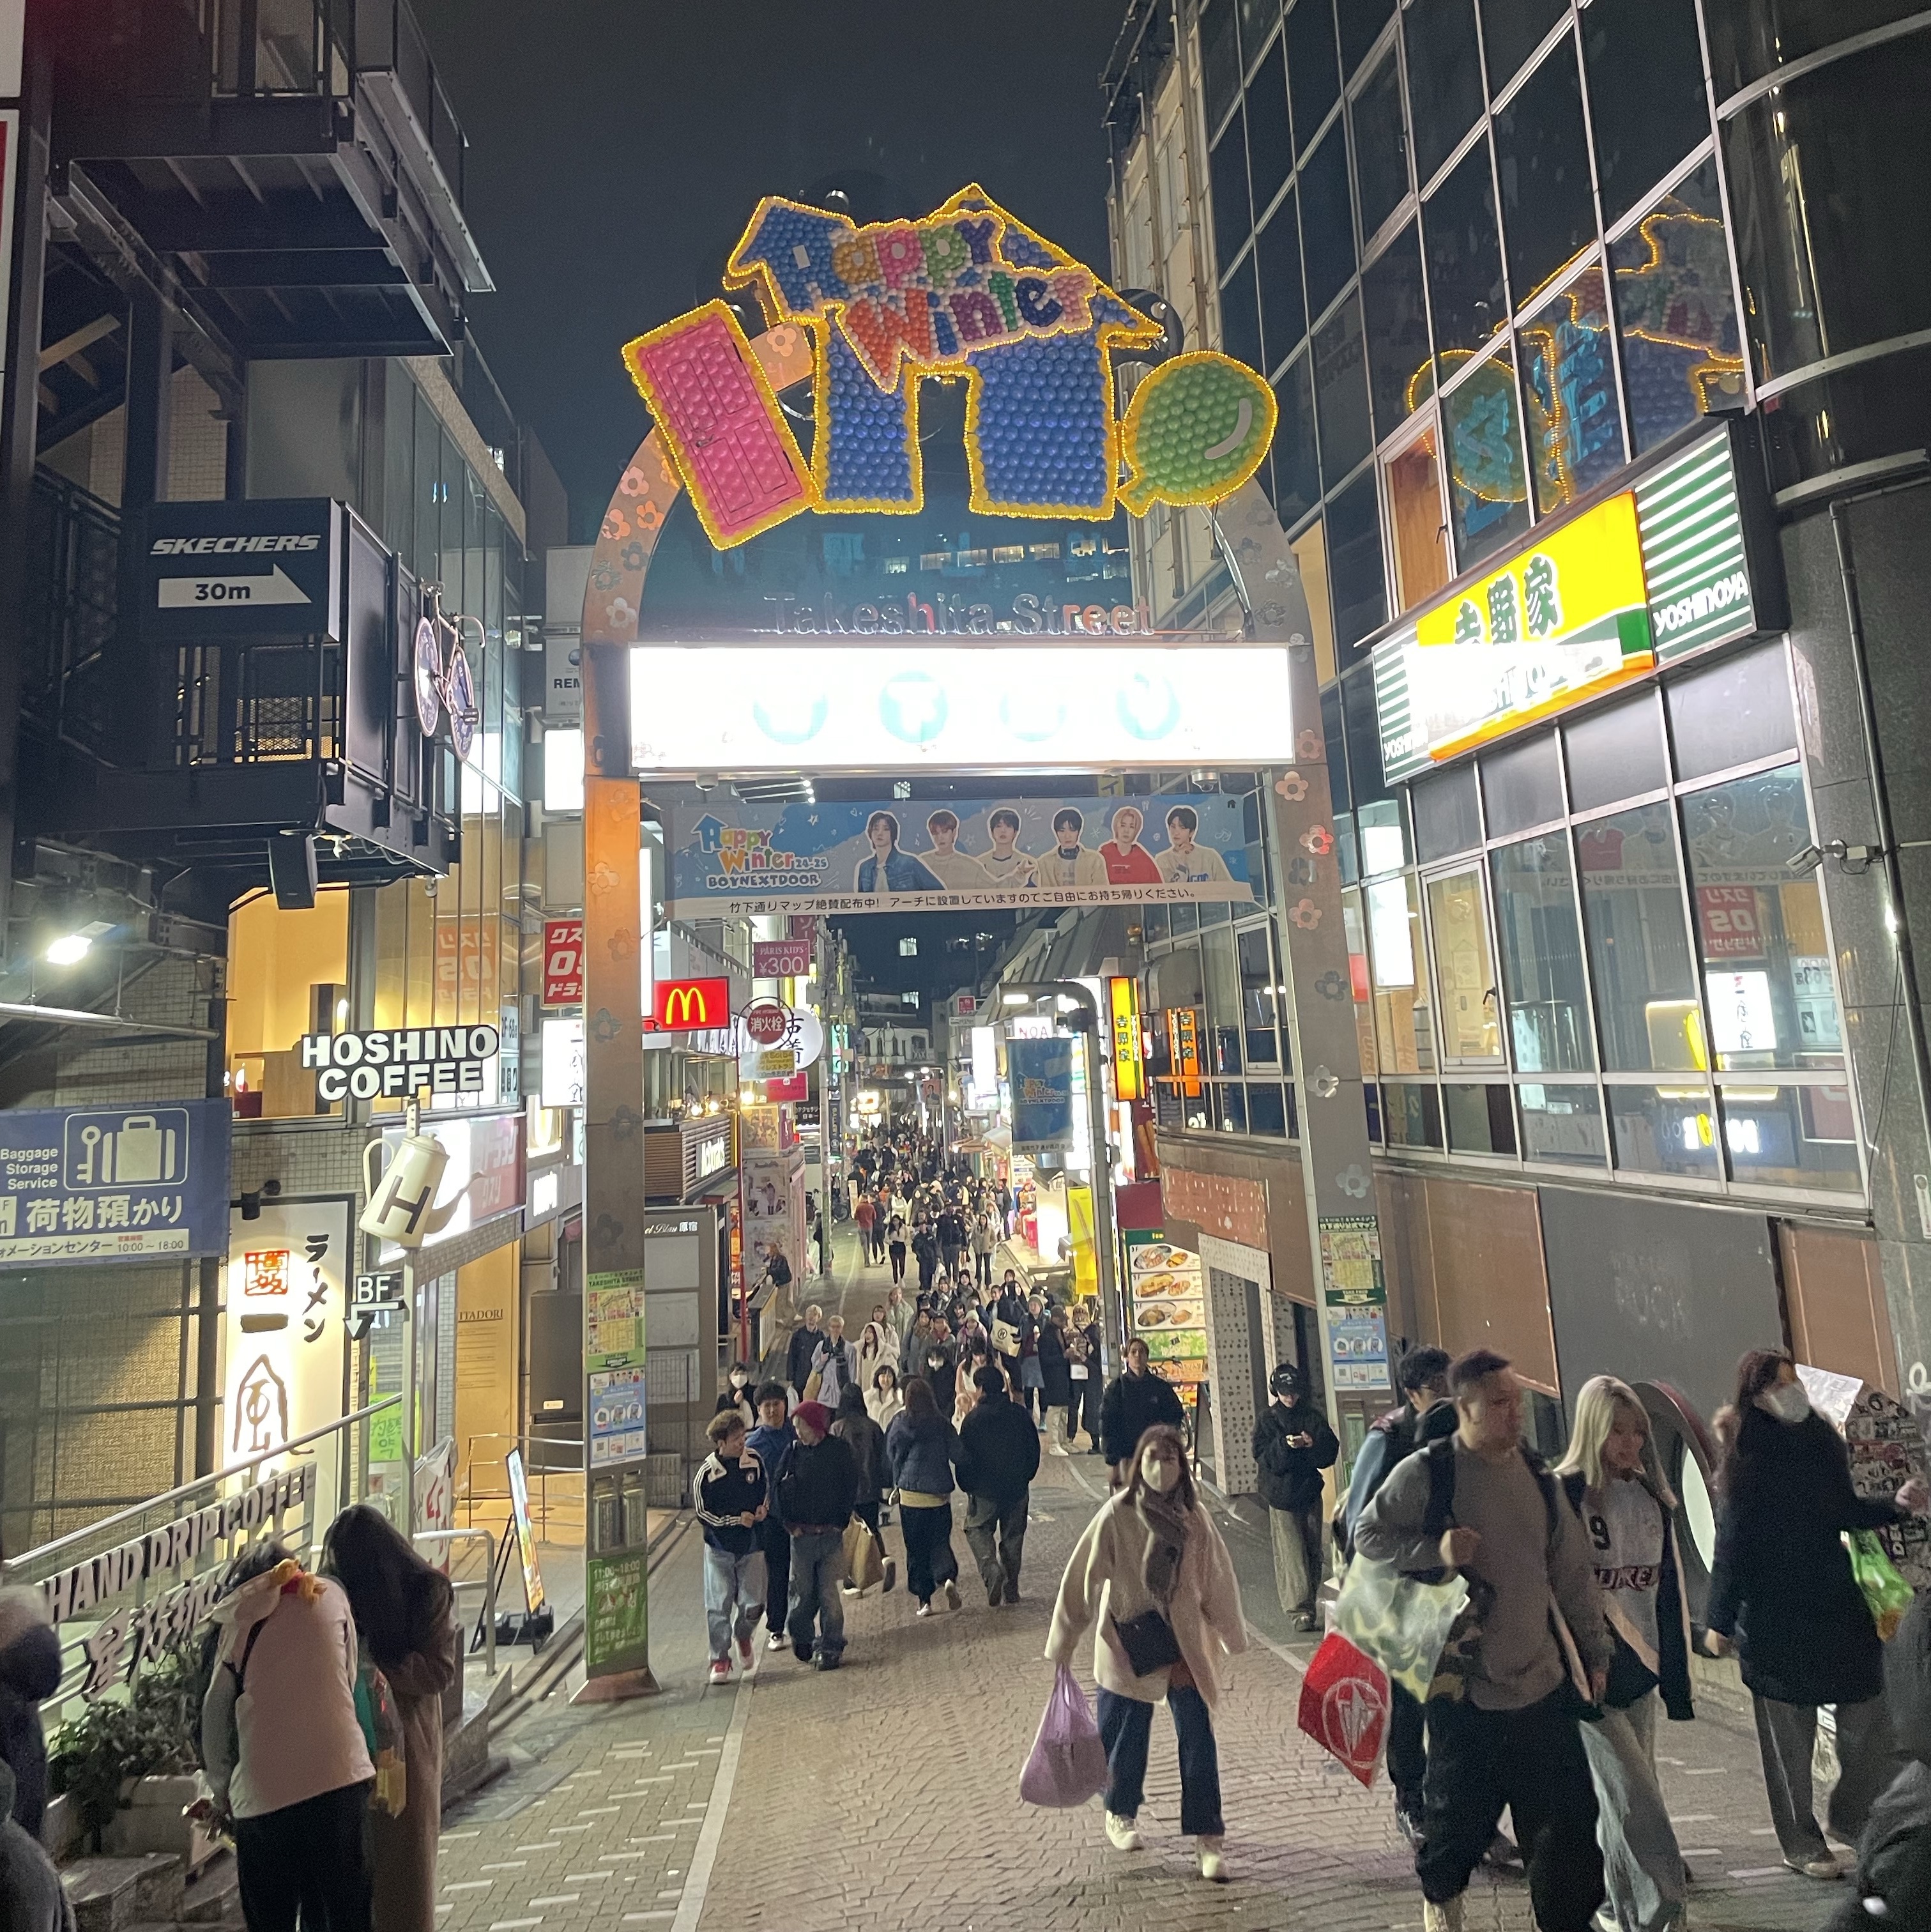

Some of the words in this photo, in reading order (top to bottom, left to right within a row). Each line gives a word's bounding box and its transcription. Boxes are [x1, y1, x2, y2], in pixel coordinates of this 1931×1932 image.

[735, 206, 996, 314] Happy
[844, 273, 1088, 378] Winter
[150, 535, 321, 555] SKECHERS
[194, 583, 252, 601] 30m
[1652, 571, 1750, 637] YOSHINOYA
[764, 591, 994, 636] Takeshita
[1013, 592, 1154, 636] Street
[692, 815, 772, 852] Happy
[720, 848, 794, 875] Winter
[708, 874, 819, 888] BOYNEXTDOOR
[550, 928, 582, 944] クス
[547, 951, 582, 976] O
[760, 946, 782, 955] PARIS
[759, 956, 804, 976] ¥300
[547, 983, 582, 997] ドラ
[751, 1016, 783, 1032] 消火栓
[1019, 1026, 1048, 1038] NOA
[302, 1026, 498, 1068] HOSHINO
[1116, 1015, 1130, 1062] 吉野家
[319, 1061, 482, 1100] COFFEE
[0, 1147, 58, 1162] Baggage
[6, 1162, 58, 1176] Storage
[8, 1177, 57, 1190] Service
[27, 1195, 183, 1232] 荷物預かり
[377, 1175, 431, 1234] H
[302, 1234, 330, 1342] ラーメン
[356, 1275, 391, 1303] BF
[459, 1309, 503, 1321] ITADORI
[45, 1542, 144, 1623] HAND
[146, 1508, 219, 1577] DRIP
[221, 1462, 317, 1535] COFFEE
